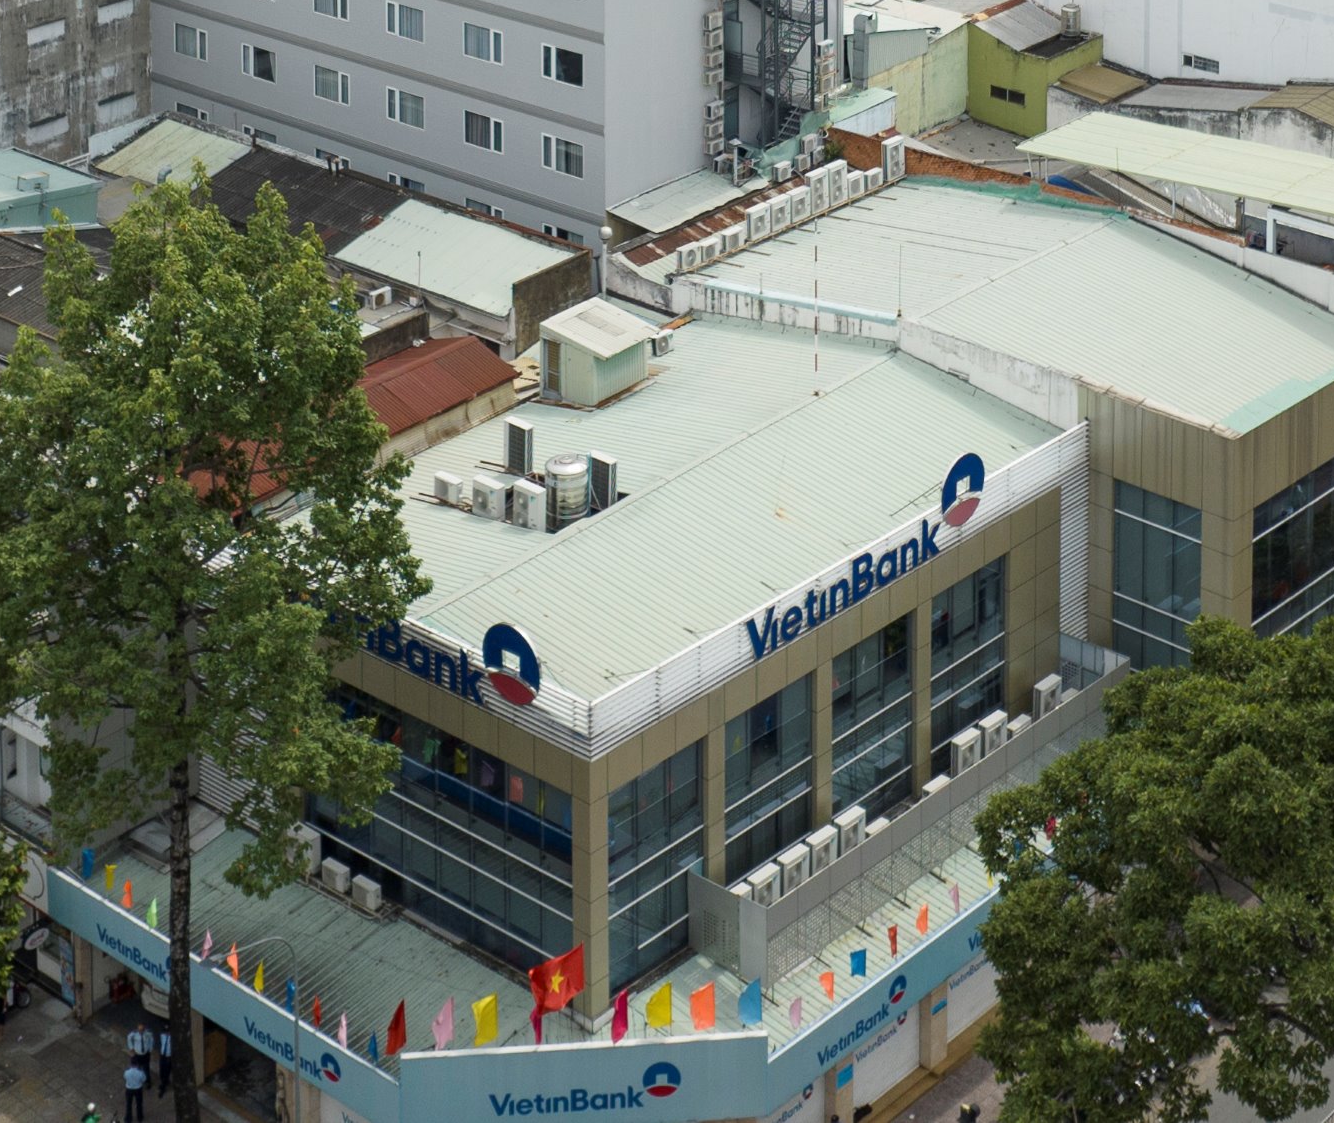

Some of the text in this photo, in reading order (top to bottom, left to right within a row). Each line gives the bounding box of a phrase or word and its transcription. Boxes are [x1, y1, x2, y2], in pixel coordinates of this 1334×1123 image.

[746, 518, 942, 661] VietinBank
[97, 922, 167, 983] VietinBank
[817, 1002, 891, 1067] VietinBank
[489, 1085, 645, 1117] VietinBank
